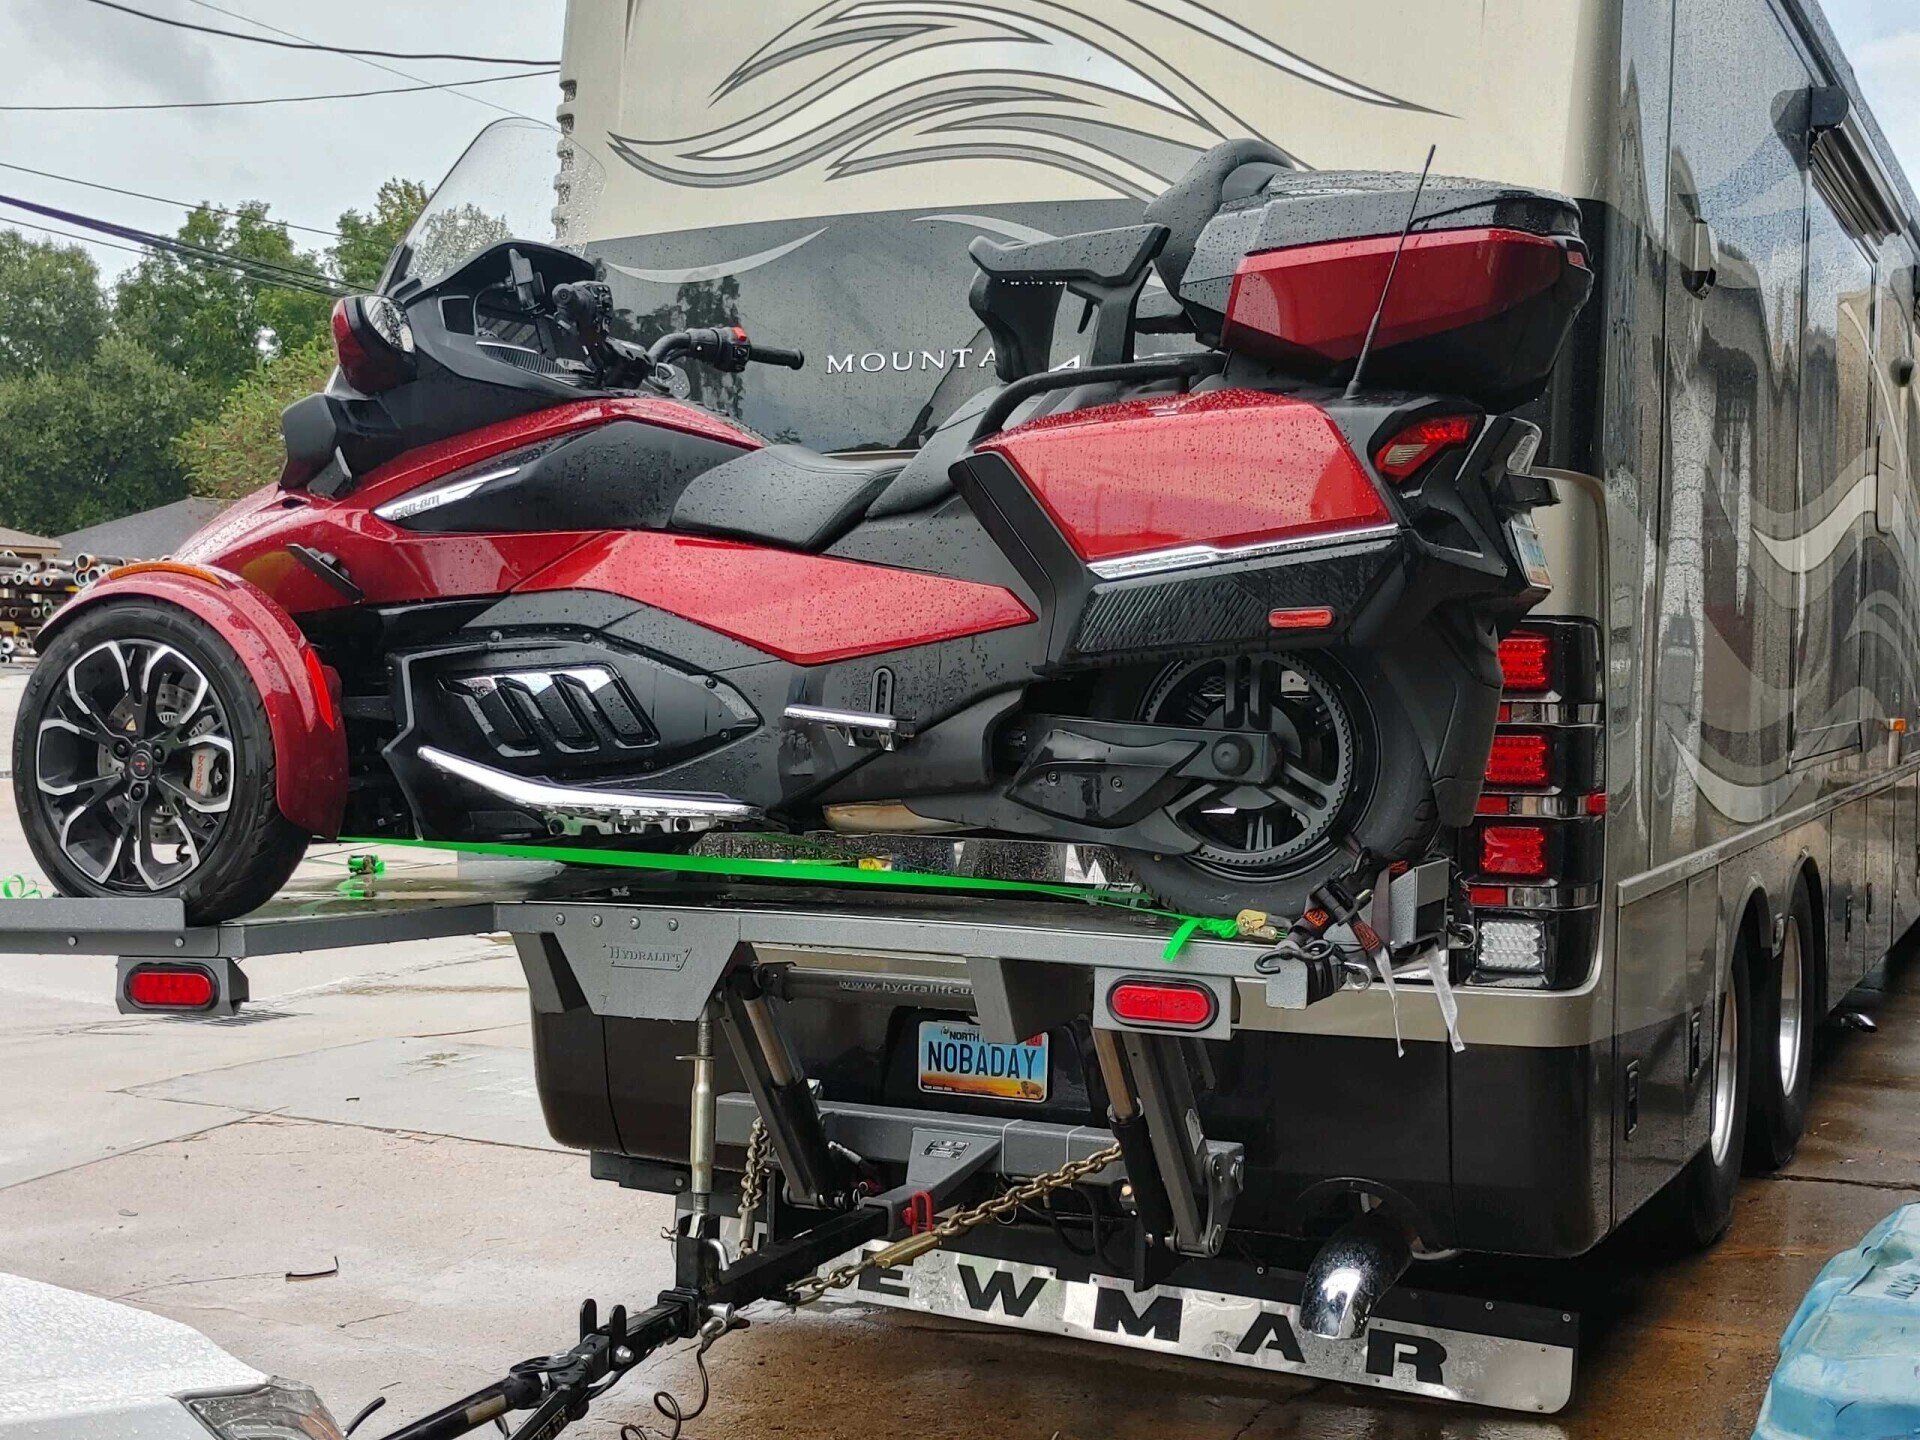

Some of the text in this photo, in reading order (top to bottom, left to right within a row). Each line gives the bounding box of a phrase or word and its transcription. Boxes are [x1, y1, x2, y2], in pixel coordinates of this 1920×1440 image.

[609, 946, 682, 962] HYDRALIFT
[949, 1031, 980, 1042] NORTH
[927, 1040, 1037, 1080] NOBADAY
[857, 1247, 1448, 1386] EWMAR
